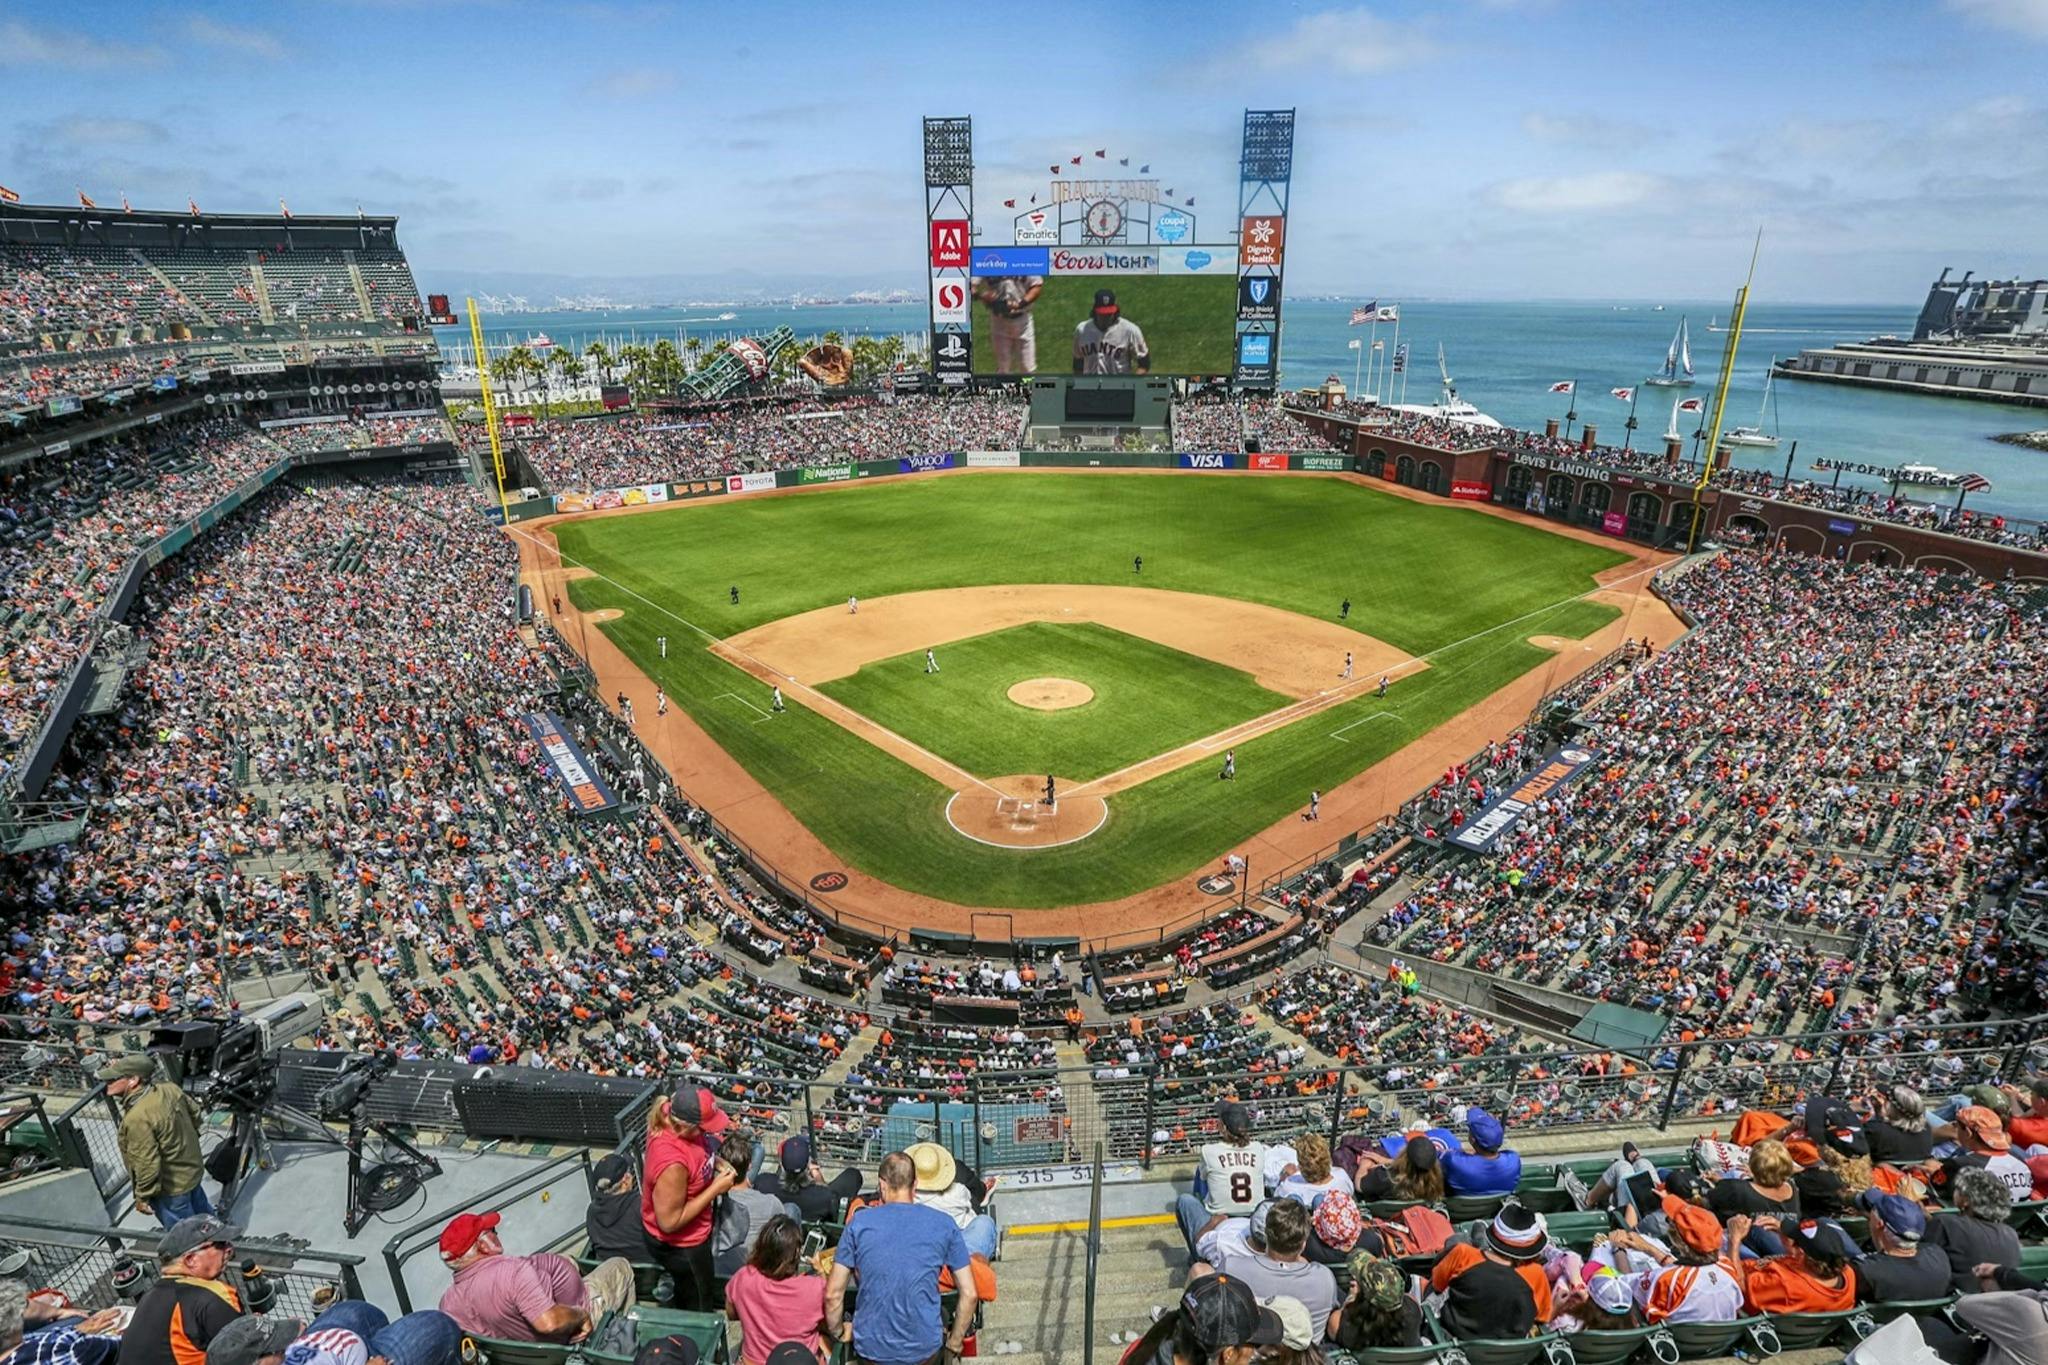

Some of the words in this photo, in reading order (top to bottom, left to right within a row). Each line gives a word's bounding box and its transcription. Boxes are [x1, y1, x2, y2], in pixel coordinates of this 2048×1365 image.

[1159, 217, 1185, 228] coupa
[1017, 228, 1058, 239] Fanatics
[940, 251, 961, 260] Adobe
[1247, 245, 1276, 257] Dignity
[975, 260, 1007, 270] workday
[1053, 249, 1104, 270] Coors
[1106, 255, 1150, 269] LIGHT
[493, 386, 601, 408] nuveen
[908, 454, 946, 468] YAHOO!
[1187, 454, 1224, 468] VISA
[1302, 457, 1343, 466] BIOFREEZE
[814, 465, 851, 478] National
[1549, 460, 1611, 482] LANDING
[1816, 457, 1855, 472] BANK
[1856, 463, 1879, 475] OF
[1878, 467, 1949, 487] AMERICA
[745, 476, 773, 486] TOYOTA
[1218, 1152, 1257, 1168] PENCE
[1017, 1168, 1054, 1185] 315
[1229, 1171, 1253, 1204] 8
